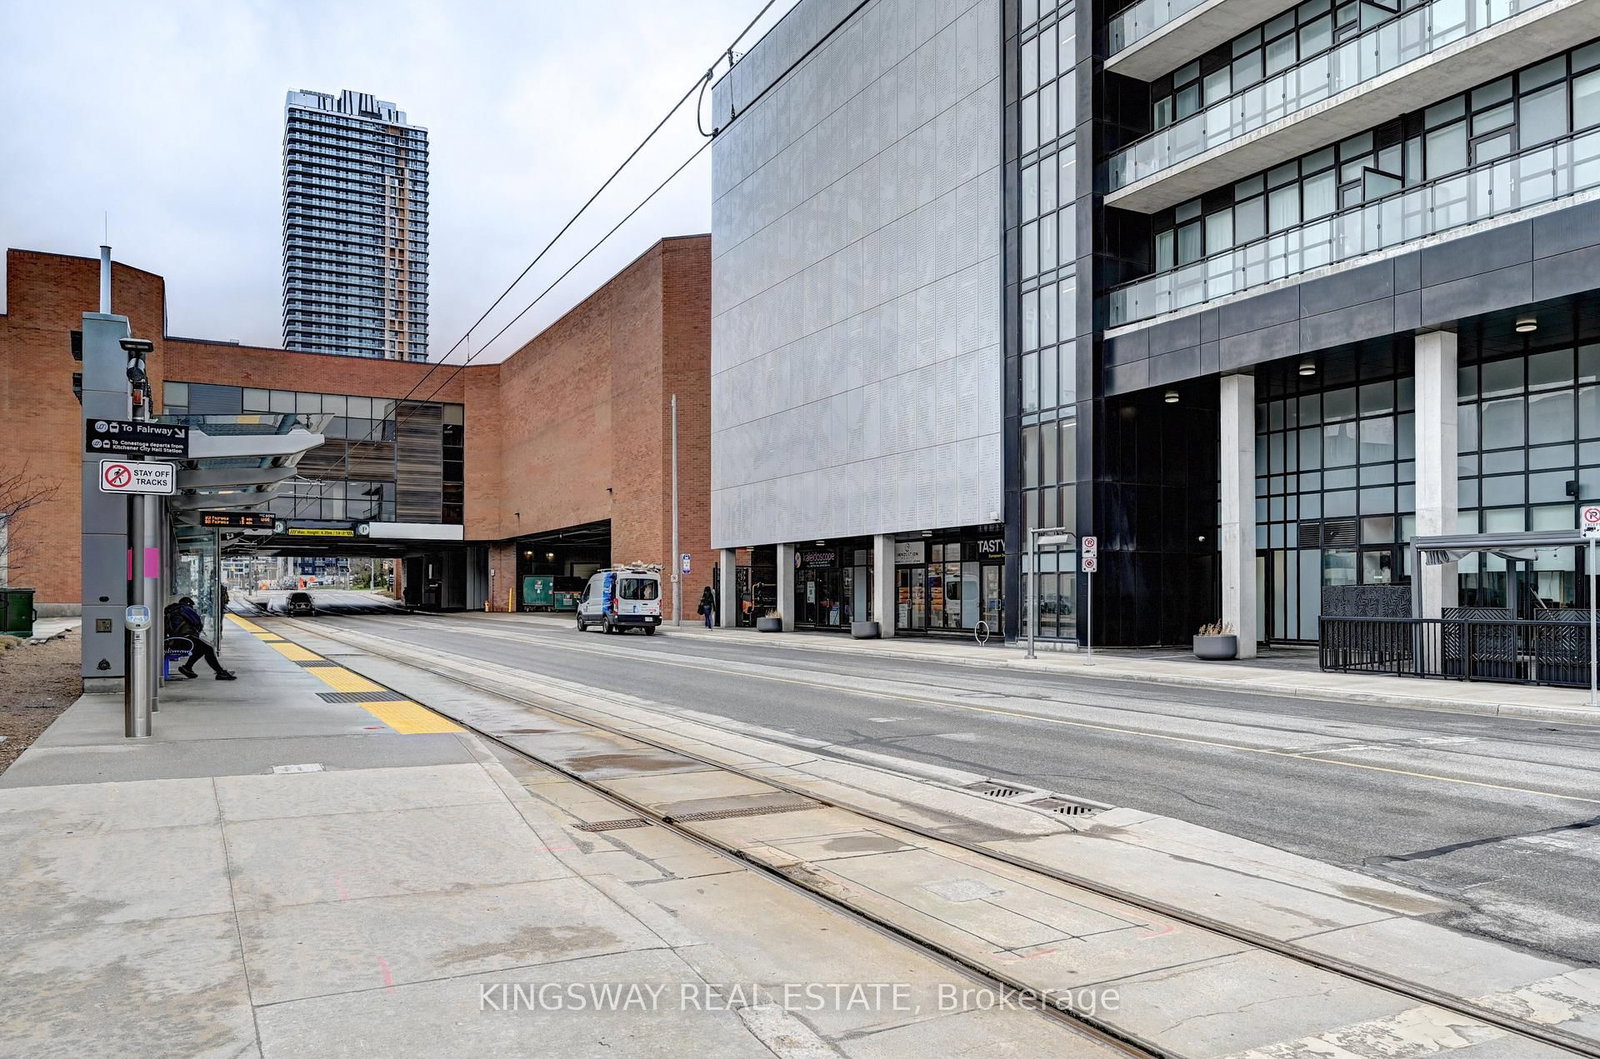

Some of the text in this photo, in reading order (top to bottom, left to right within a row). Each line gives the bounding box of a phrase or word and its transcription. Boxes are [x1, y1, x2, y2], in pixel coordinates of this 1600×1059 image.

[121, 424, 173, 436] To Fairway
[120, 440, 149, 448] Conestoga
[133, 469, 170, 478] STAY OFF
[136, 478, 168, 486] TRACKS
[977, 539, 1005, 553] TASTY
